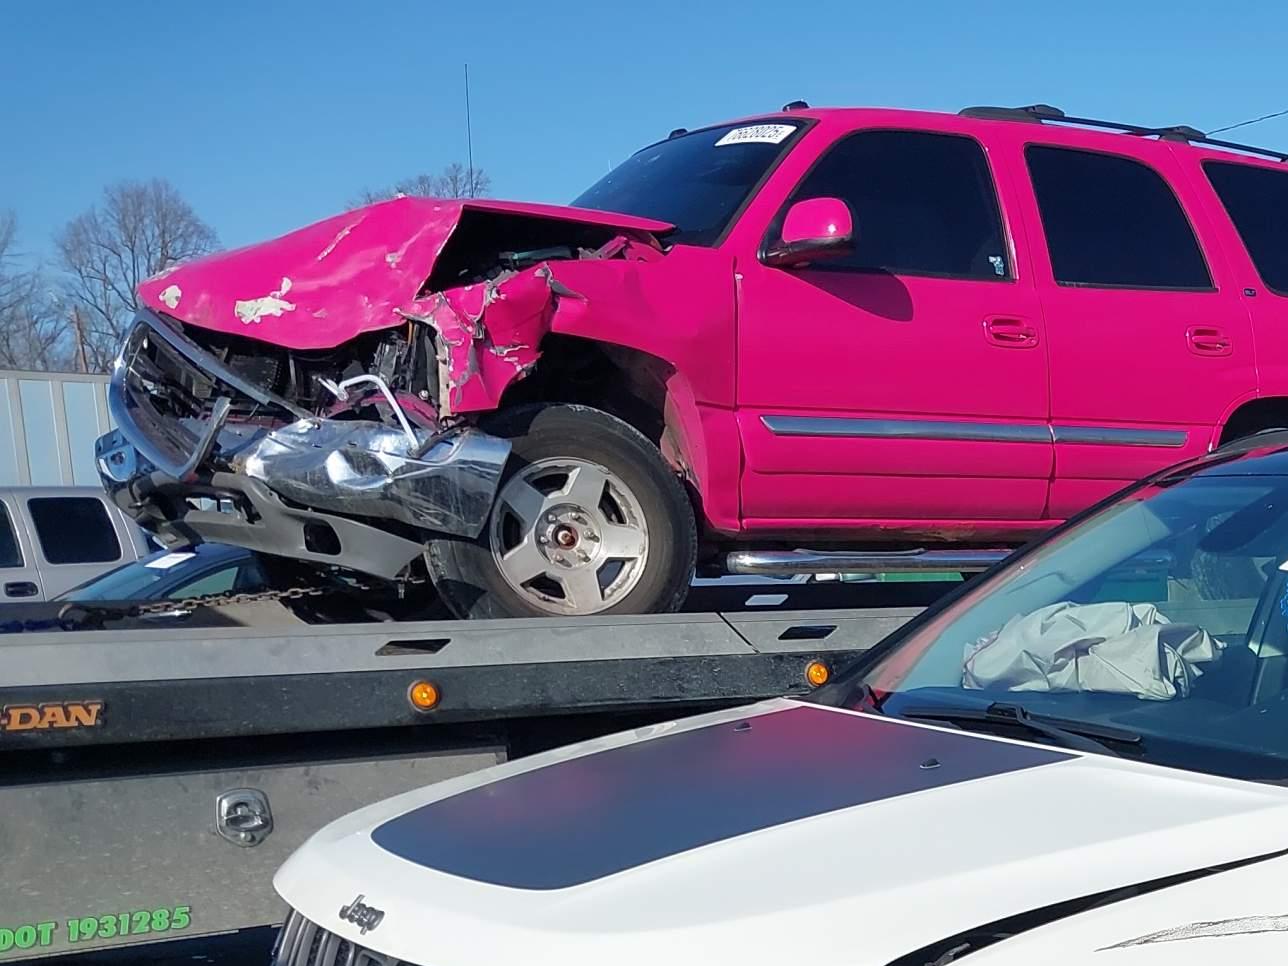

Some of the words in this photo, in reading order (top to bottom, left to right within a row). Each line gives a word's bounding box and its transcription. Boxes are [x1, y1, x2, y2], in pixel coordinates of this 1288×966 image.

[0, 922, 57, 952] DOT
[67, 906, 192, 943] 1931285
[338, 894, 386, 936] Jeep
